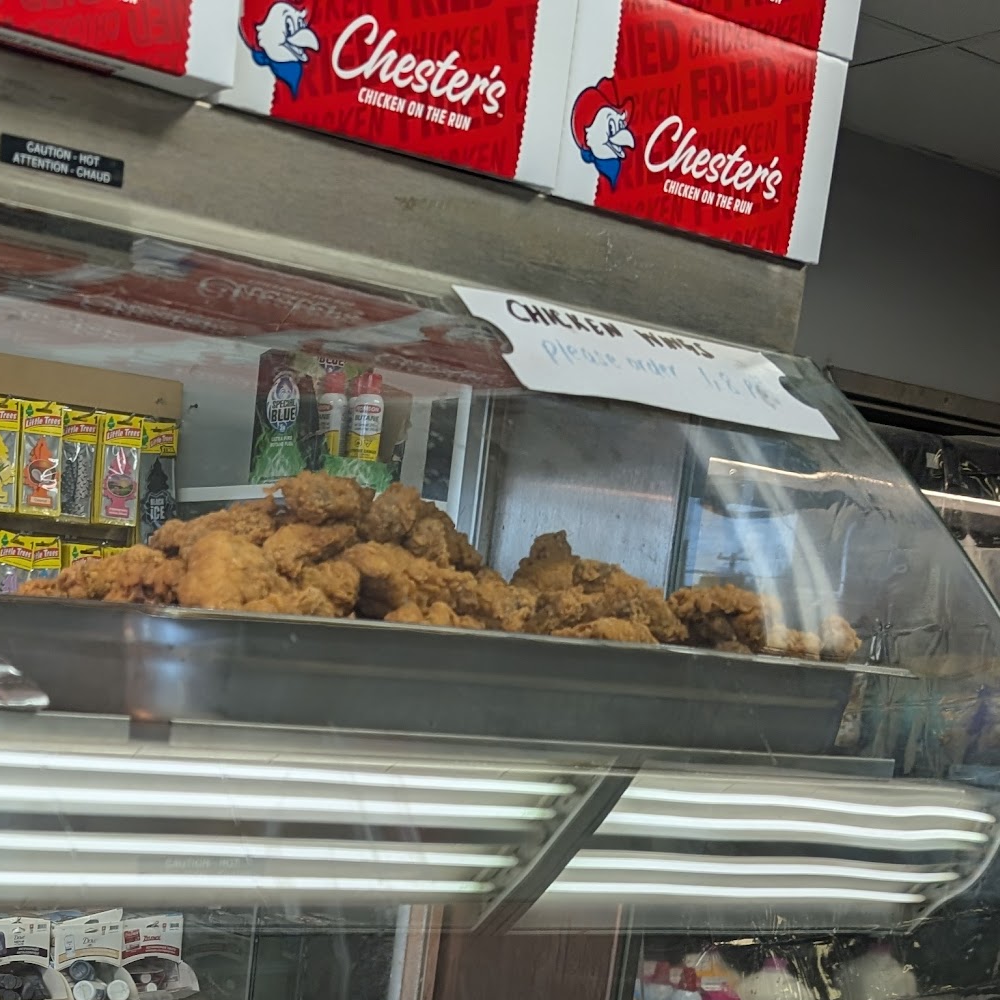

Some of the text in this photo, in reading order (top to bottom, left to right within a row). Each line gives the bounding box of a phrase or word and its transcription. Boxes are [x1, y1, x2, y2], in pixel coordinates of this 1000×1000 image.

[331, 14, 506, 115] Chester's
[358, 87, 472, 131] CHICKEN ON THE RUN
[12, 152, 112, 183] ATTENTION CHAUD
[26, 141, 100, 167] CAUTION HOT
[644, 115, 783, 201] Chester's
[663, 178, 754, 215] CHICKEN ON THE RUN
[506, 299, 622, 338] CHICKEN
[0, 411, 18, 420] Trees
[271, 408, 296, 422] BLUE
